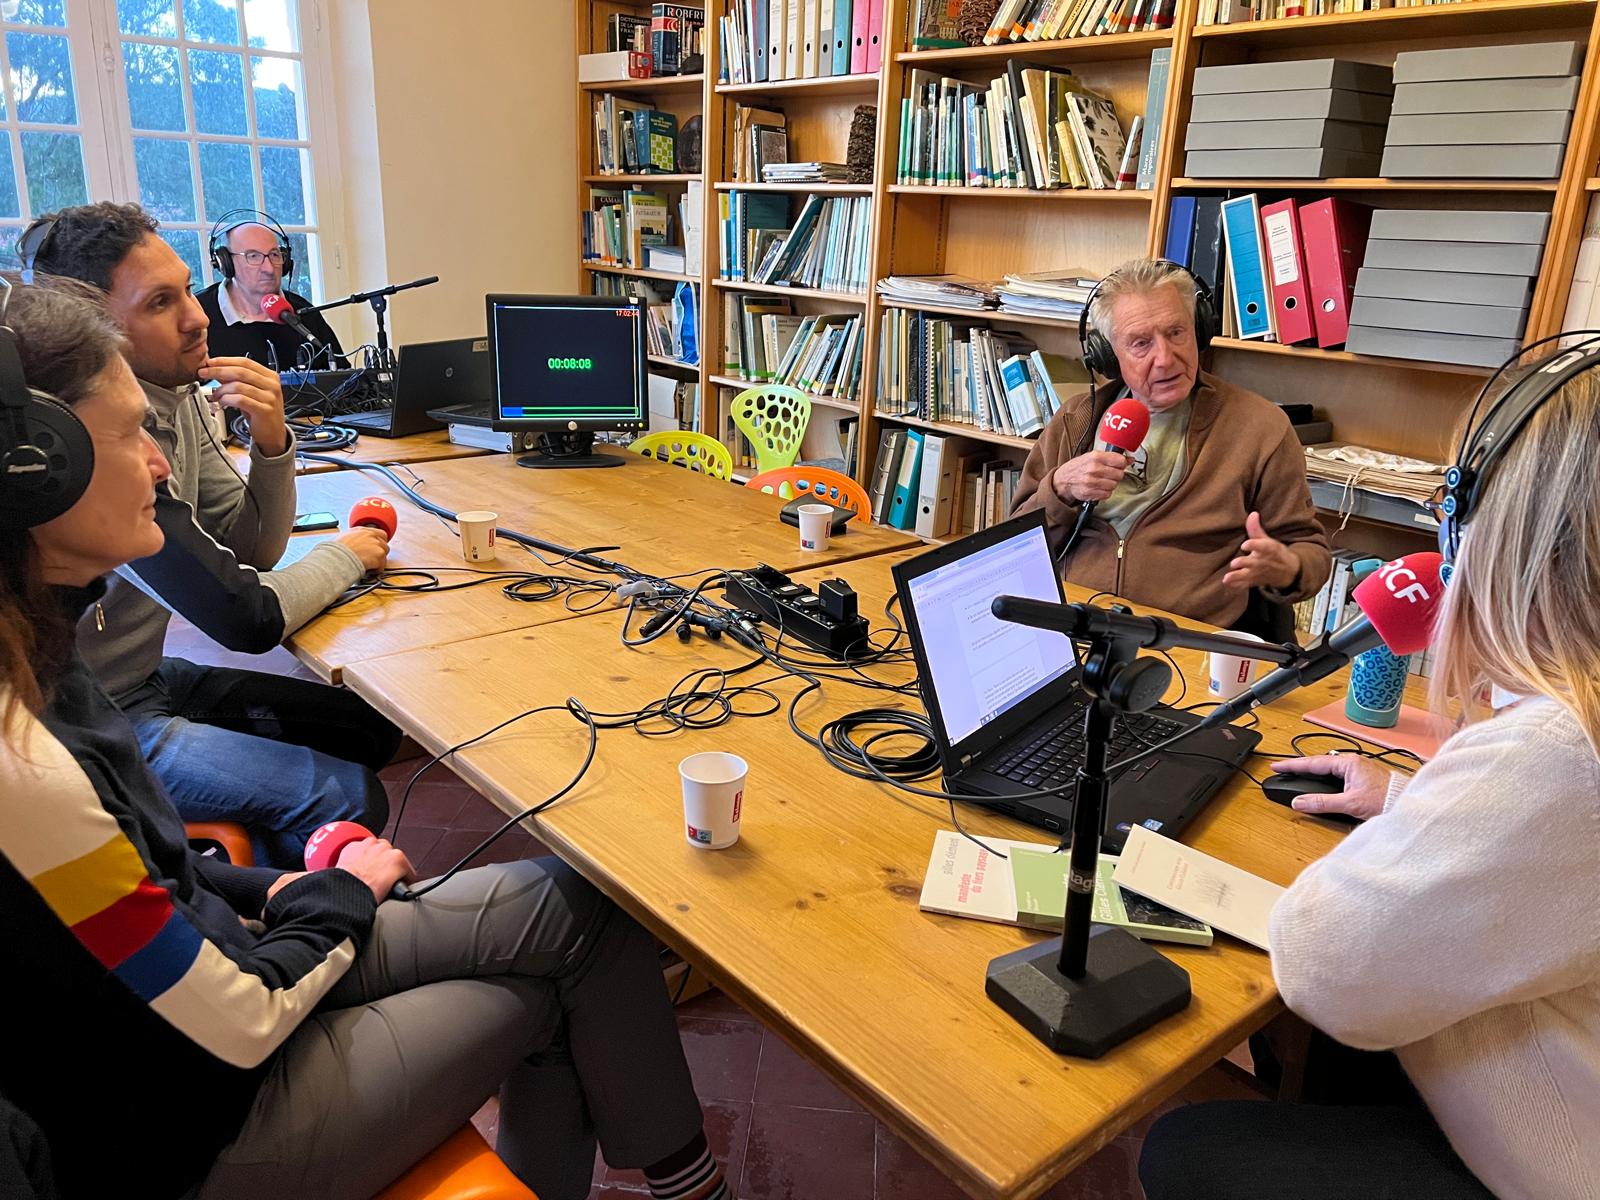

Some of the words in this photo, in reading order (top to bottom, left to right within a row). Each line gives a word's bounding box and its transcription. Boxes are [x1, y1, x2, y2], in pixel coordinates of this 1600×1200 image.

[667, 7, 704, 19] ROBERT
[548, 358, 592, 369] 00:08:08
[1104, 412, 1132, 430] RCF
[1379, 558, 1430, 604] RCF
[1070, 870, 1095, 891] tag
